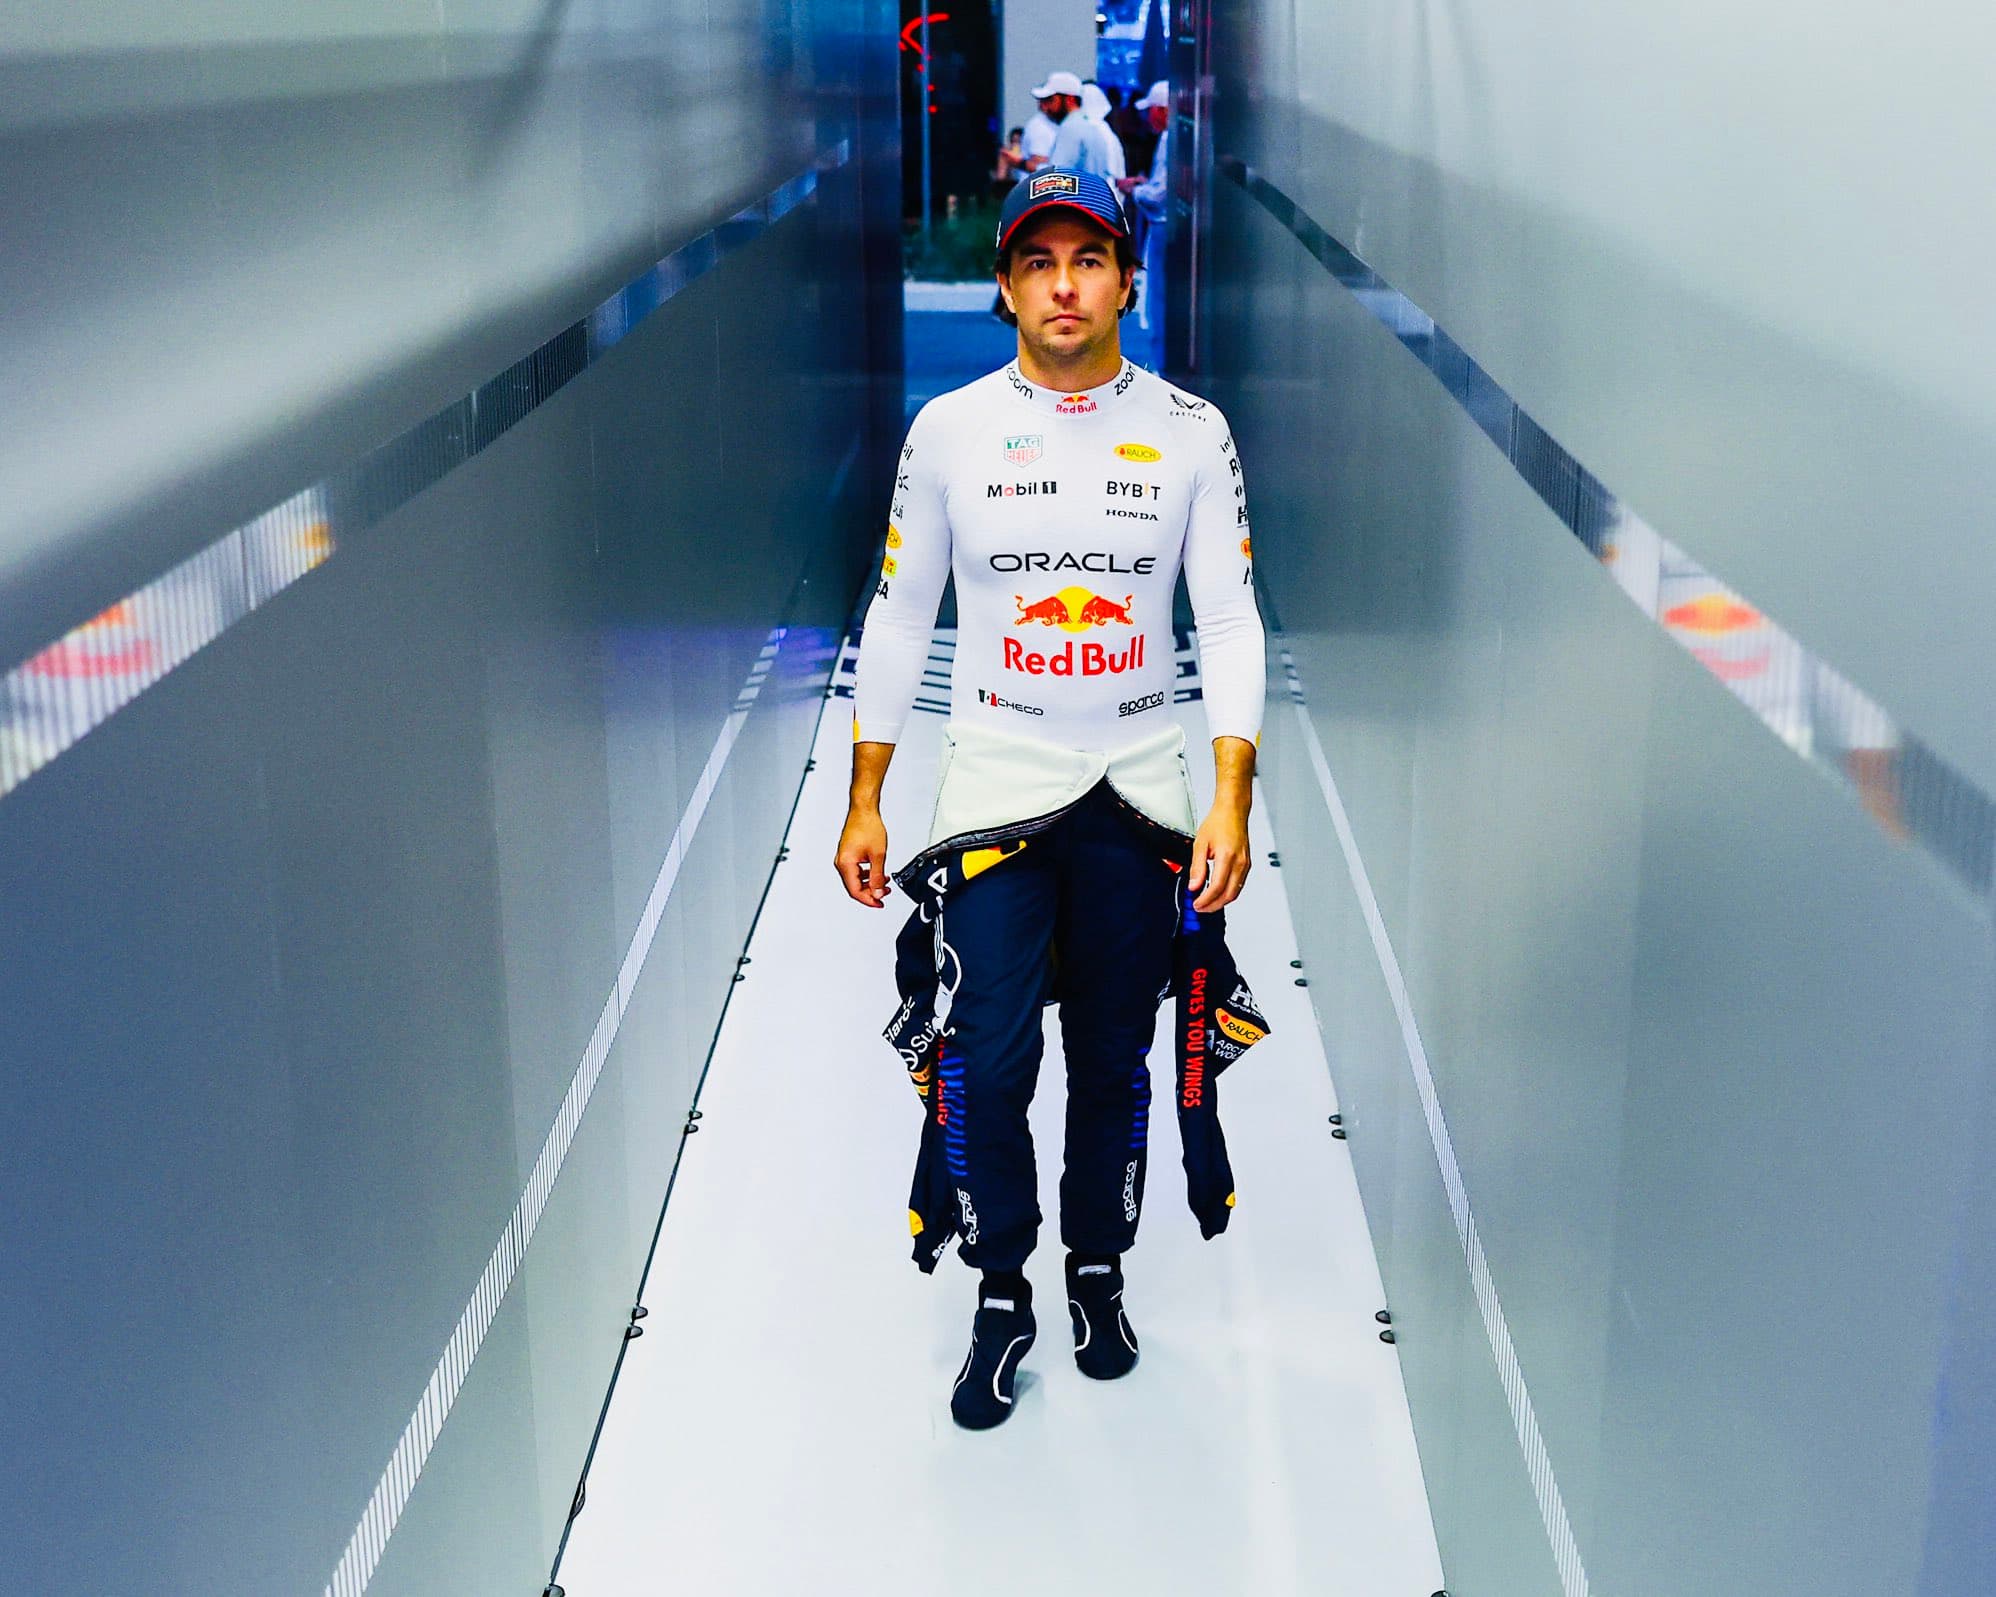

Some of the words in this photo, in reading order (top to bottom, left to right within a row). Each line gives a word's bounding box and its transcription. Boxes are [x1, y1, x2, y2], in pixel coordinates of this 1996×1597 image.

[1055, 403, 1076, 414] Red
[1077, 401, 1097, 413] Bull
[1007, 438, 1039, 449] TAG
[1126, 447, 1156, 459] RAUCH
[987, 481, 1037, 498] Mobil
[1042, 481, 1057, 494] 1
[1106, 480, 1161, 500] BYBIT
[1105, 508, 1160, 521] HONDA
[989, 551, 1157, 575] ORACLE
[1003, 636, 1073, 676] Red
[1081, 633, 1145, 676] Bull
[997, 697, 1044, 717] CHECO
[1118, 691, 1165, 718] sparco
[1188, 967, 1208, 1015] GIVES
[1185, 1017, 1206, 1052] YOU
[1183, 1054, 1205, 1109] WINGS
[1121, 1159, 1138, 1223] sparco
